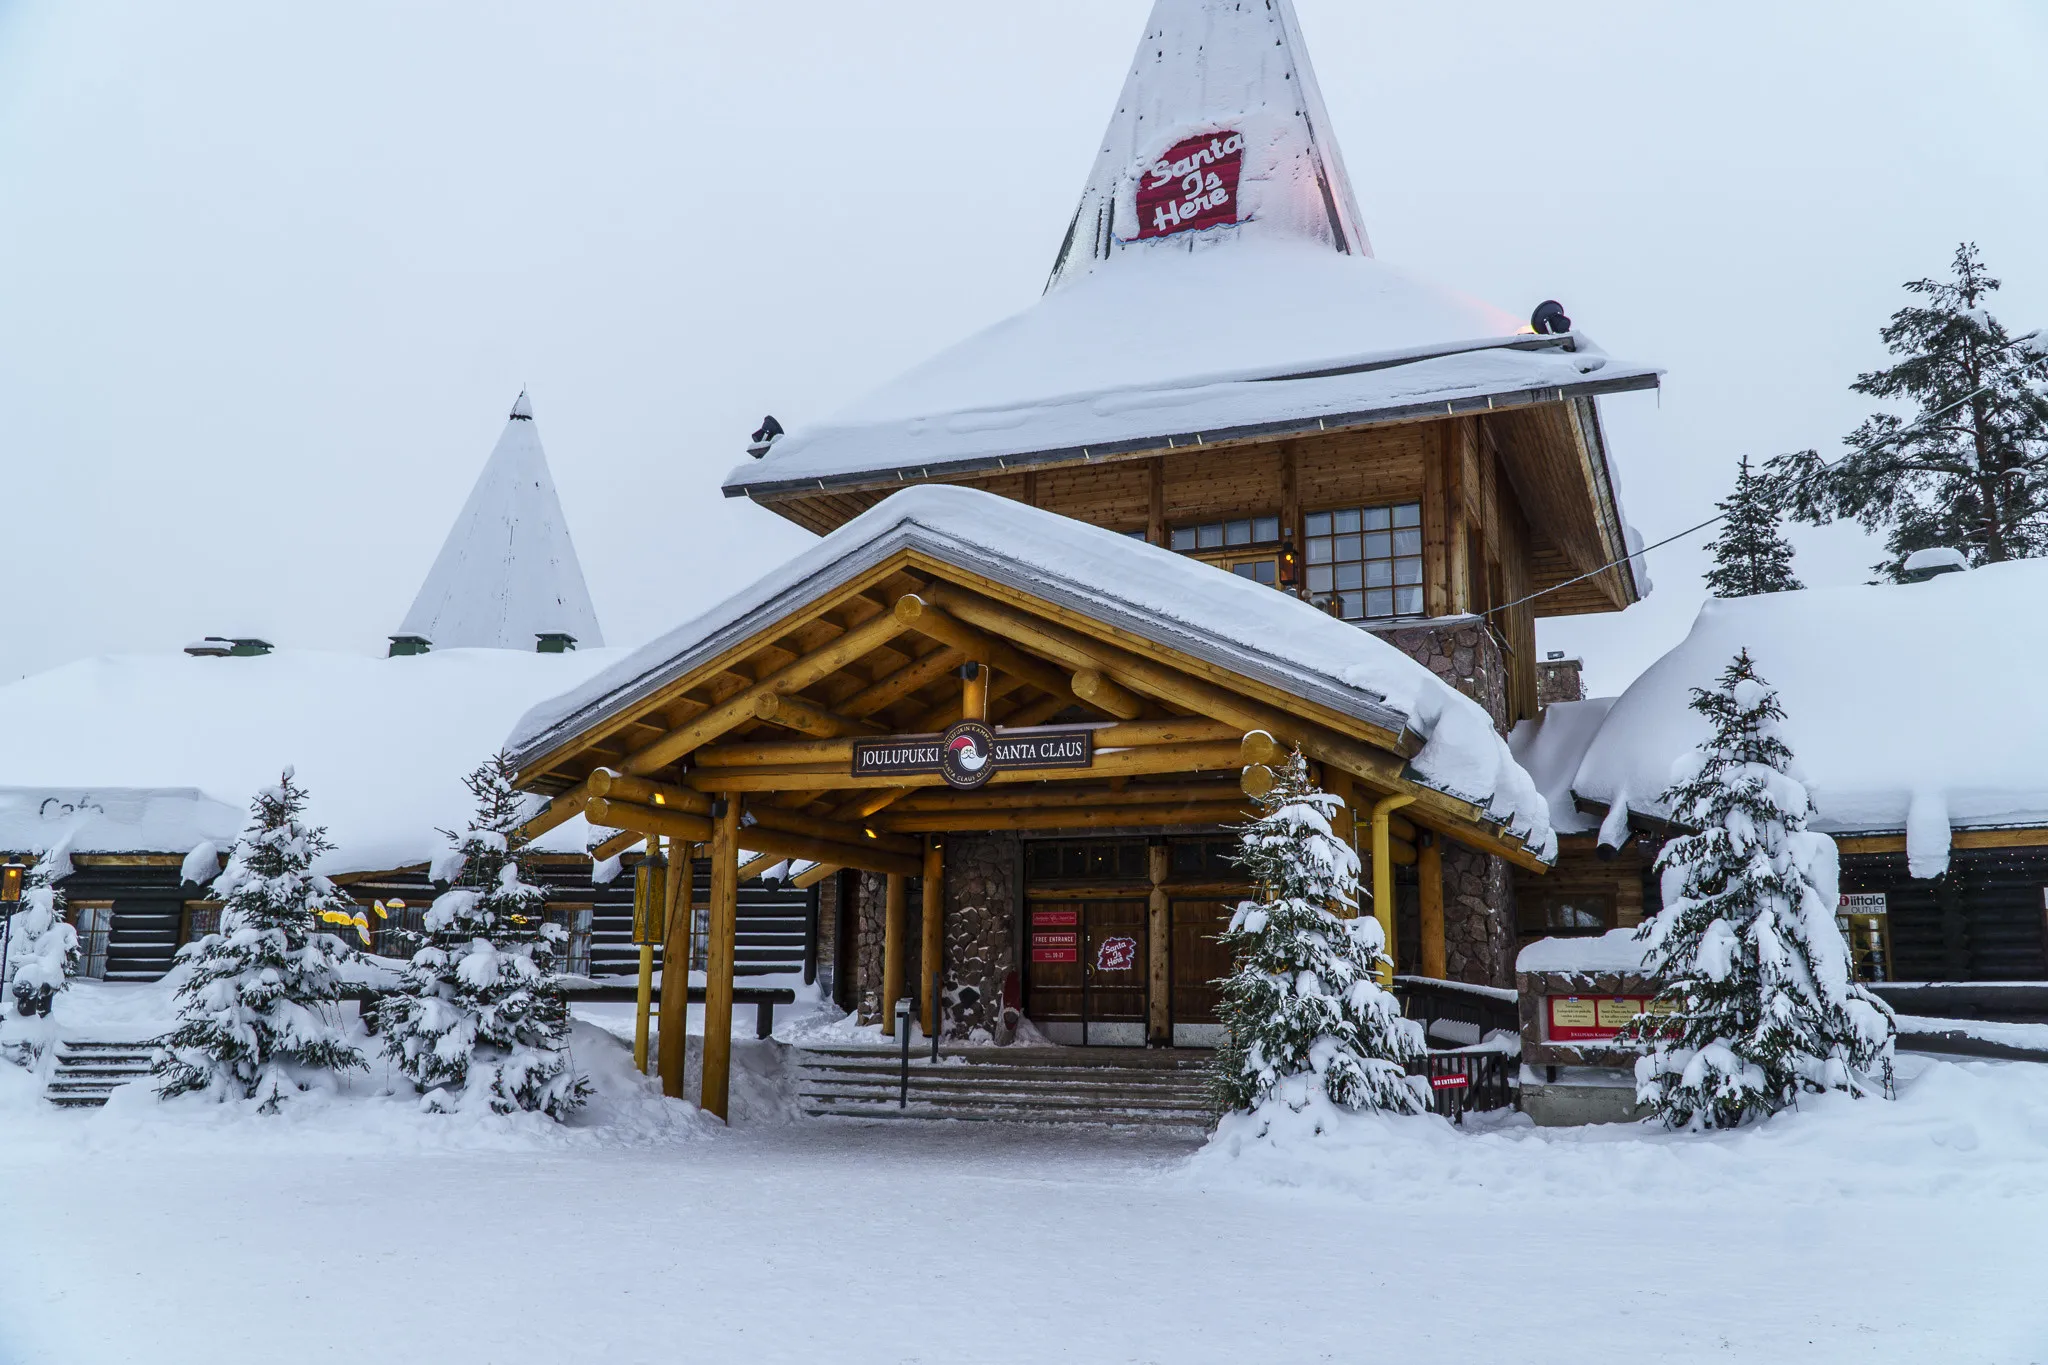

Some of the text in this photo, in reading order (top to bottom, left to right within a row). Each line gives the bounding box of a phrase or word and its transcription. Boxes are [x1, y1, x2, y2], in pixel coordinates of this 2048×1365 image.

[1148, 134, 1245, 190] Santa
[1182, 169, 1222, 200] Is
[1153, 187, 1229, 232] Here
[862, 747, 939, 767] JOULUPUKKI
[995, 741, 1082, 760] SANTA CLAUS
[1850, 895, 1884, 906] iittala
[1851, 906, 1885, 914] OUTLET
[1105, 942, 1126, 954] Santa
[1107, 956, 1124, 967] Here
[1441, 1077, 1466, 1085] ENTRANCE
